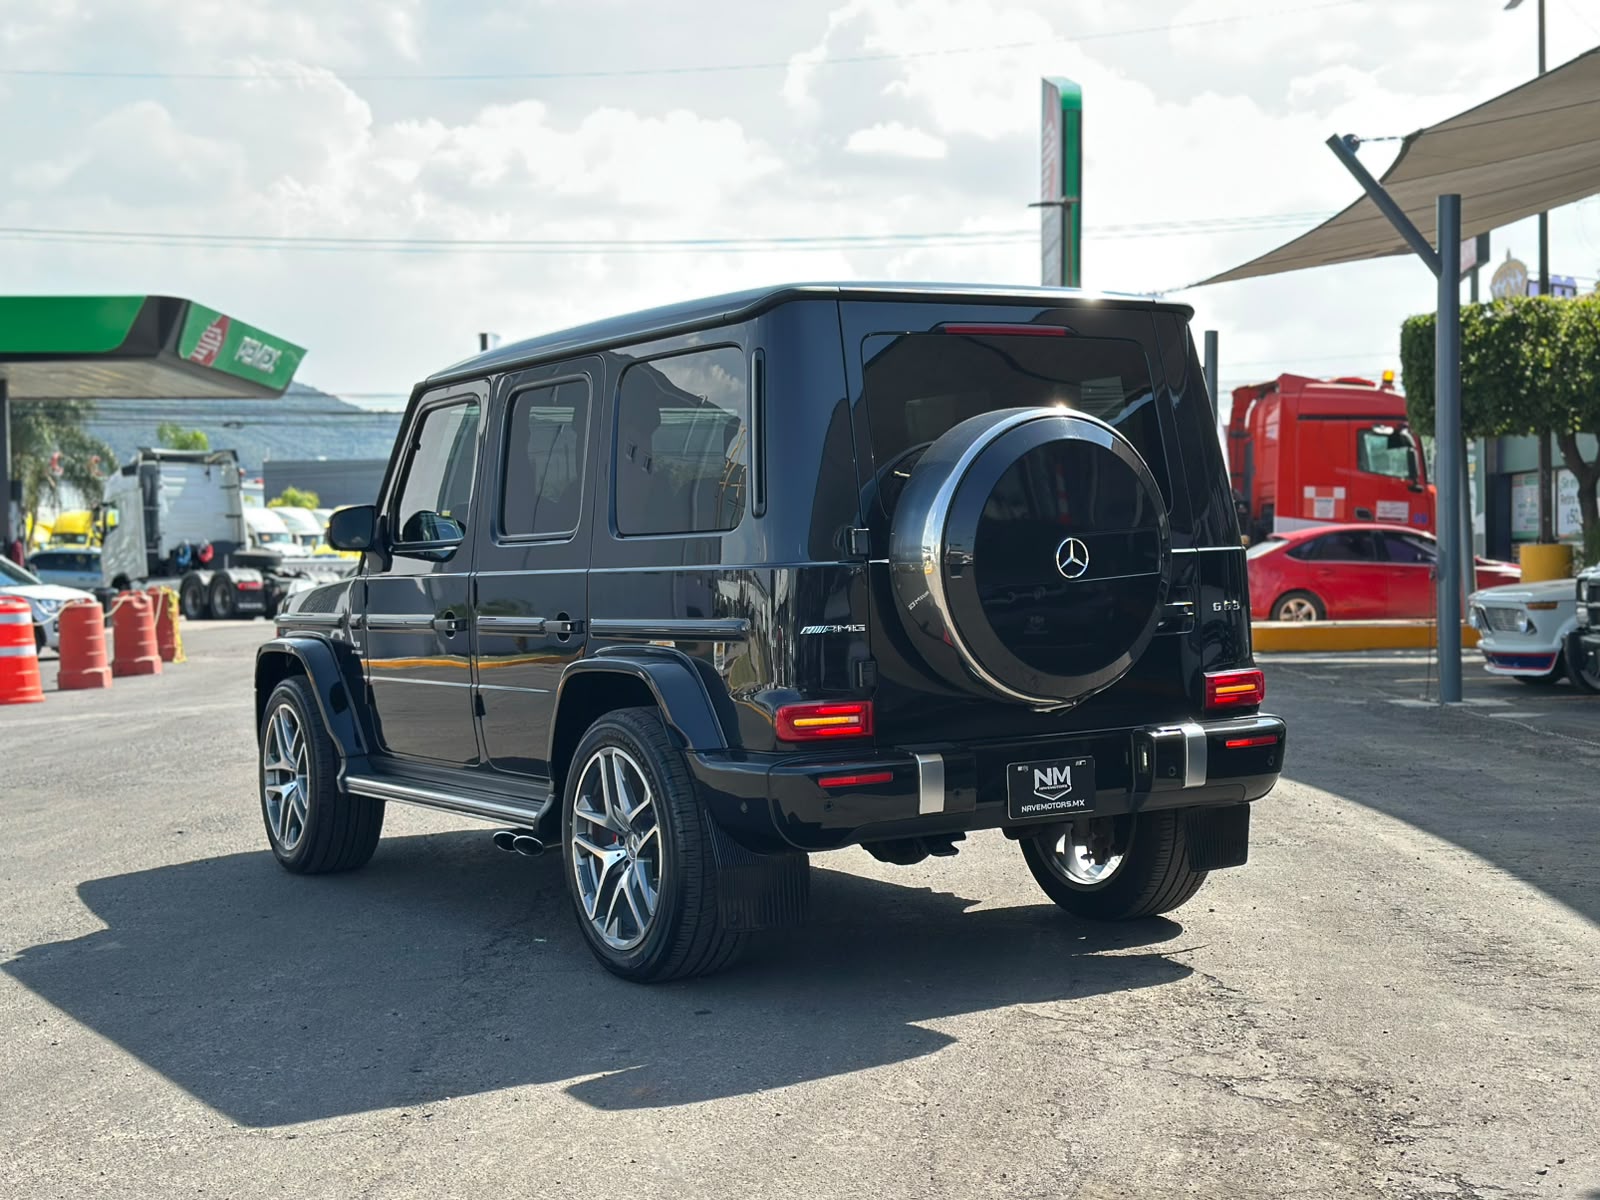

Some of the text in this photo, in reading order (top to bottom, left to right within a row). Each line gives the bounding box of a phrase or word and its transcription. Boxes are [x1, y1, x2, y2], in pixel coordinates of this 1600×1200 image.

[819, 624, 866, 634] AMG
[1034, 766, 1071, 790] NM
[1021, 799, 1086, 813] NAVEMOTORS.MX
